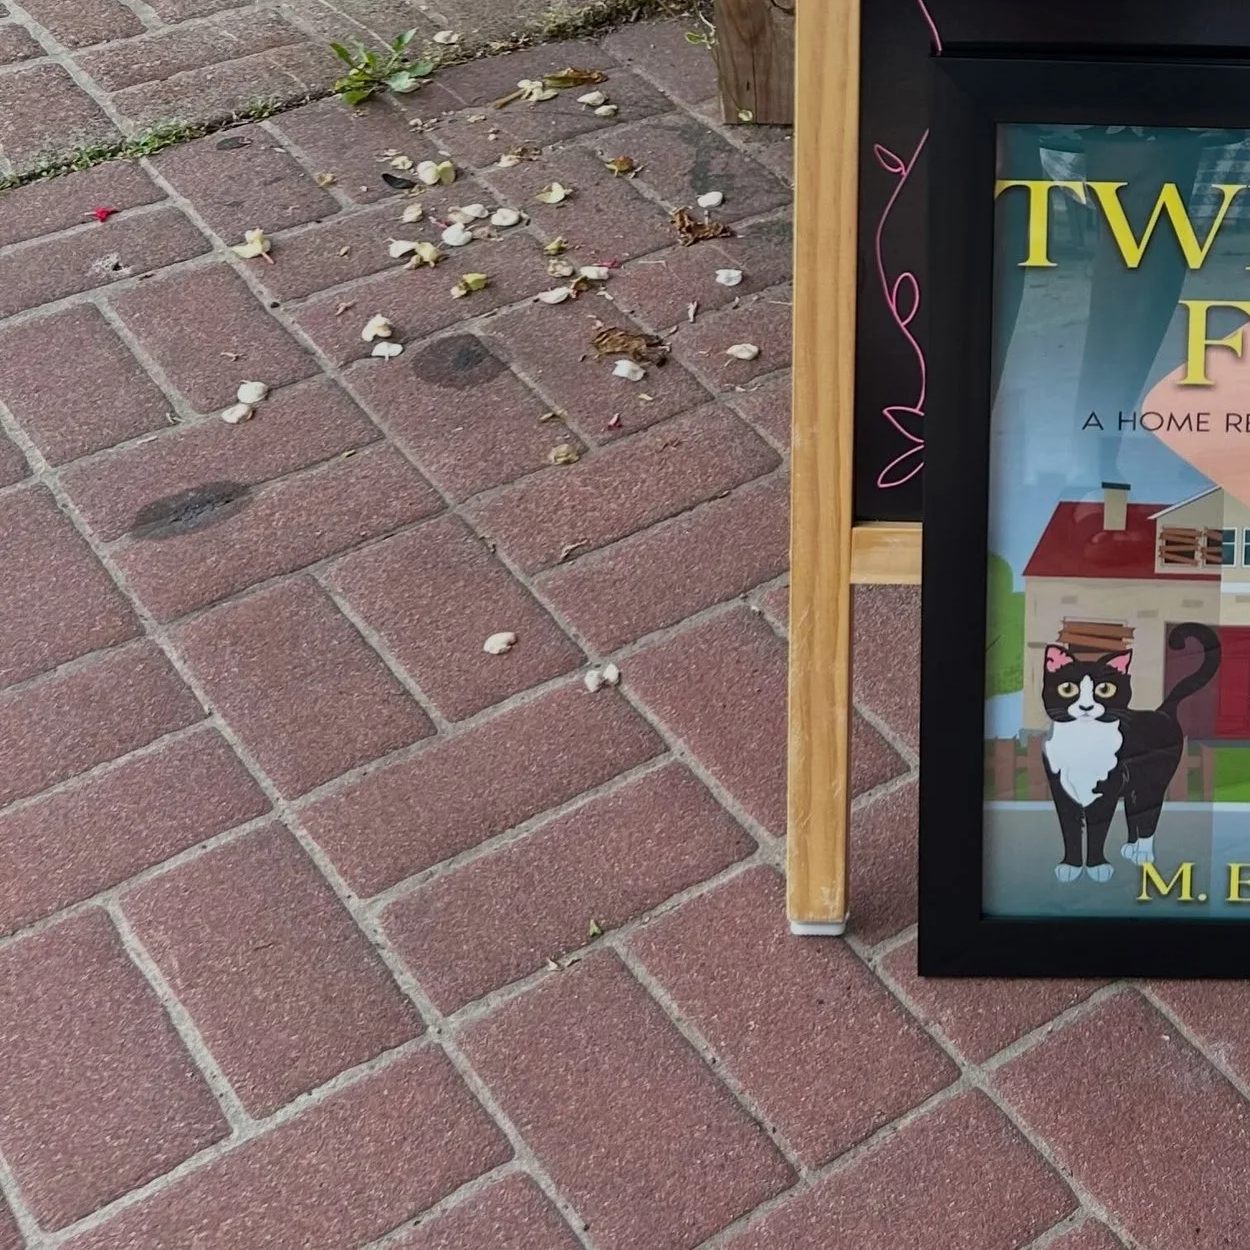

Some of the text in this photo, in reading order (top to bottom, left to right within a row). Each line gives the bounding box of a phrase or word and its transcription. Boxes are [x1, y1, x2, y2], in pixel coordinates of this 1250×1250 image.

[1081, 410, 1105, 432] A
[1117, 411, 1211, 433] HOME
[1135, 860, 1208, 903] M.
